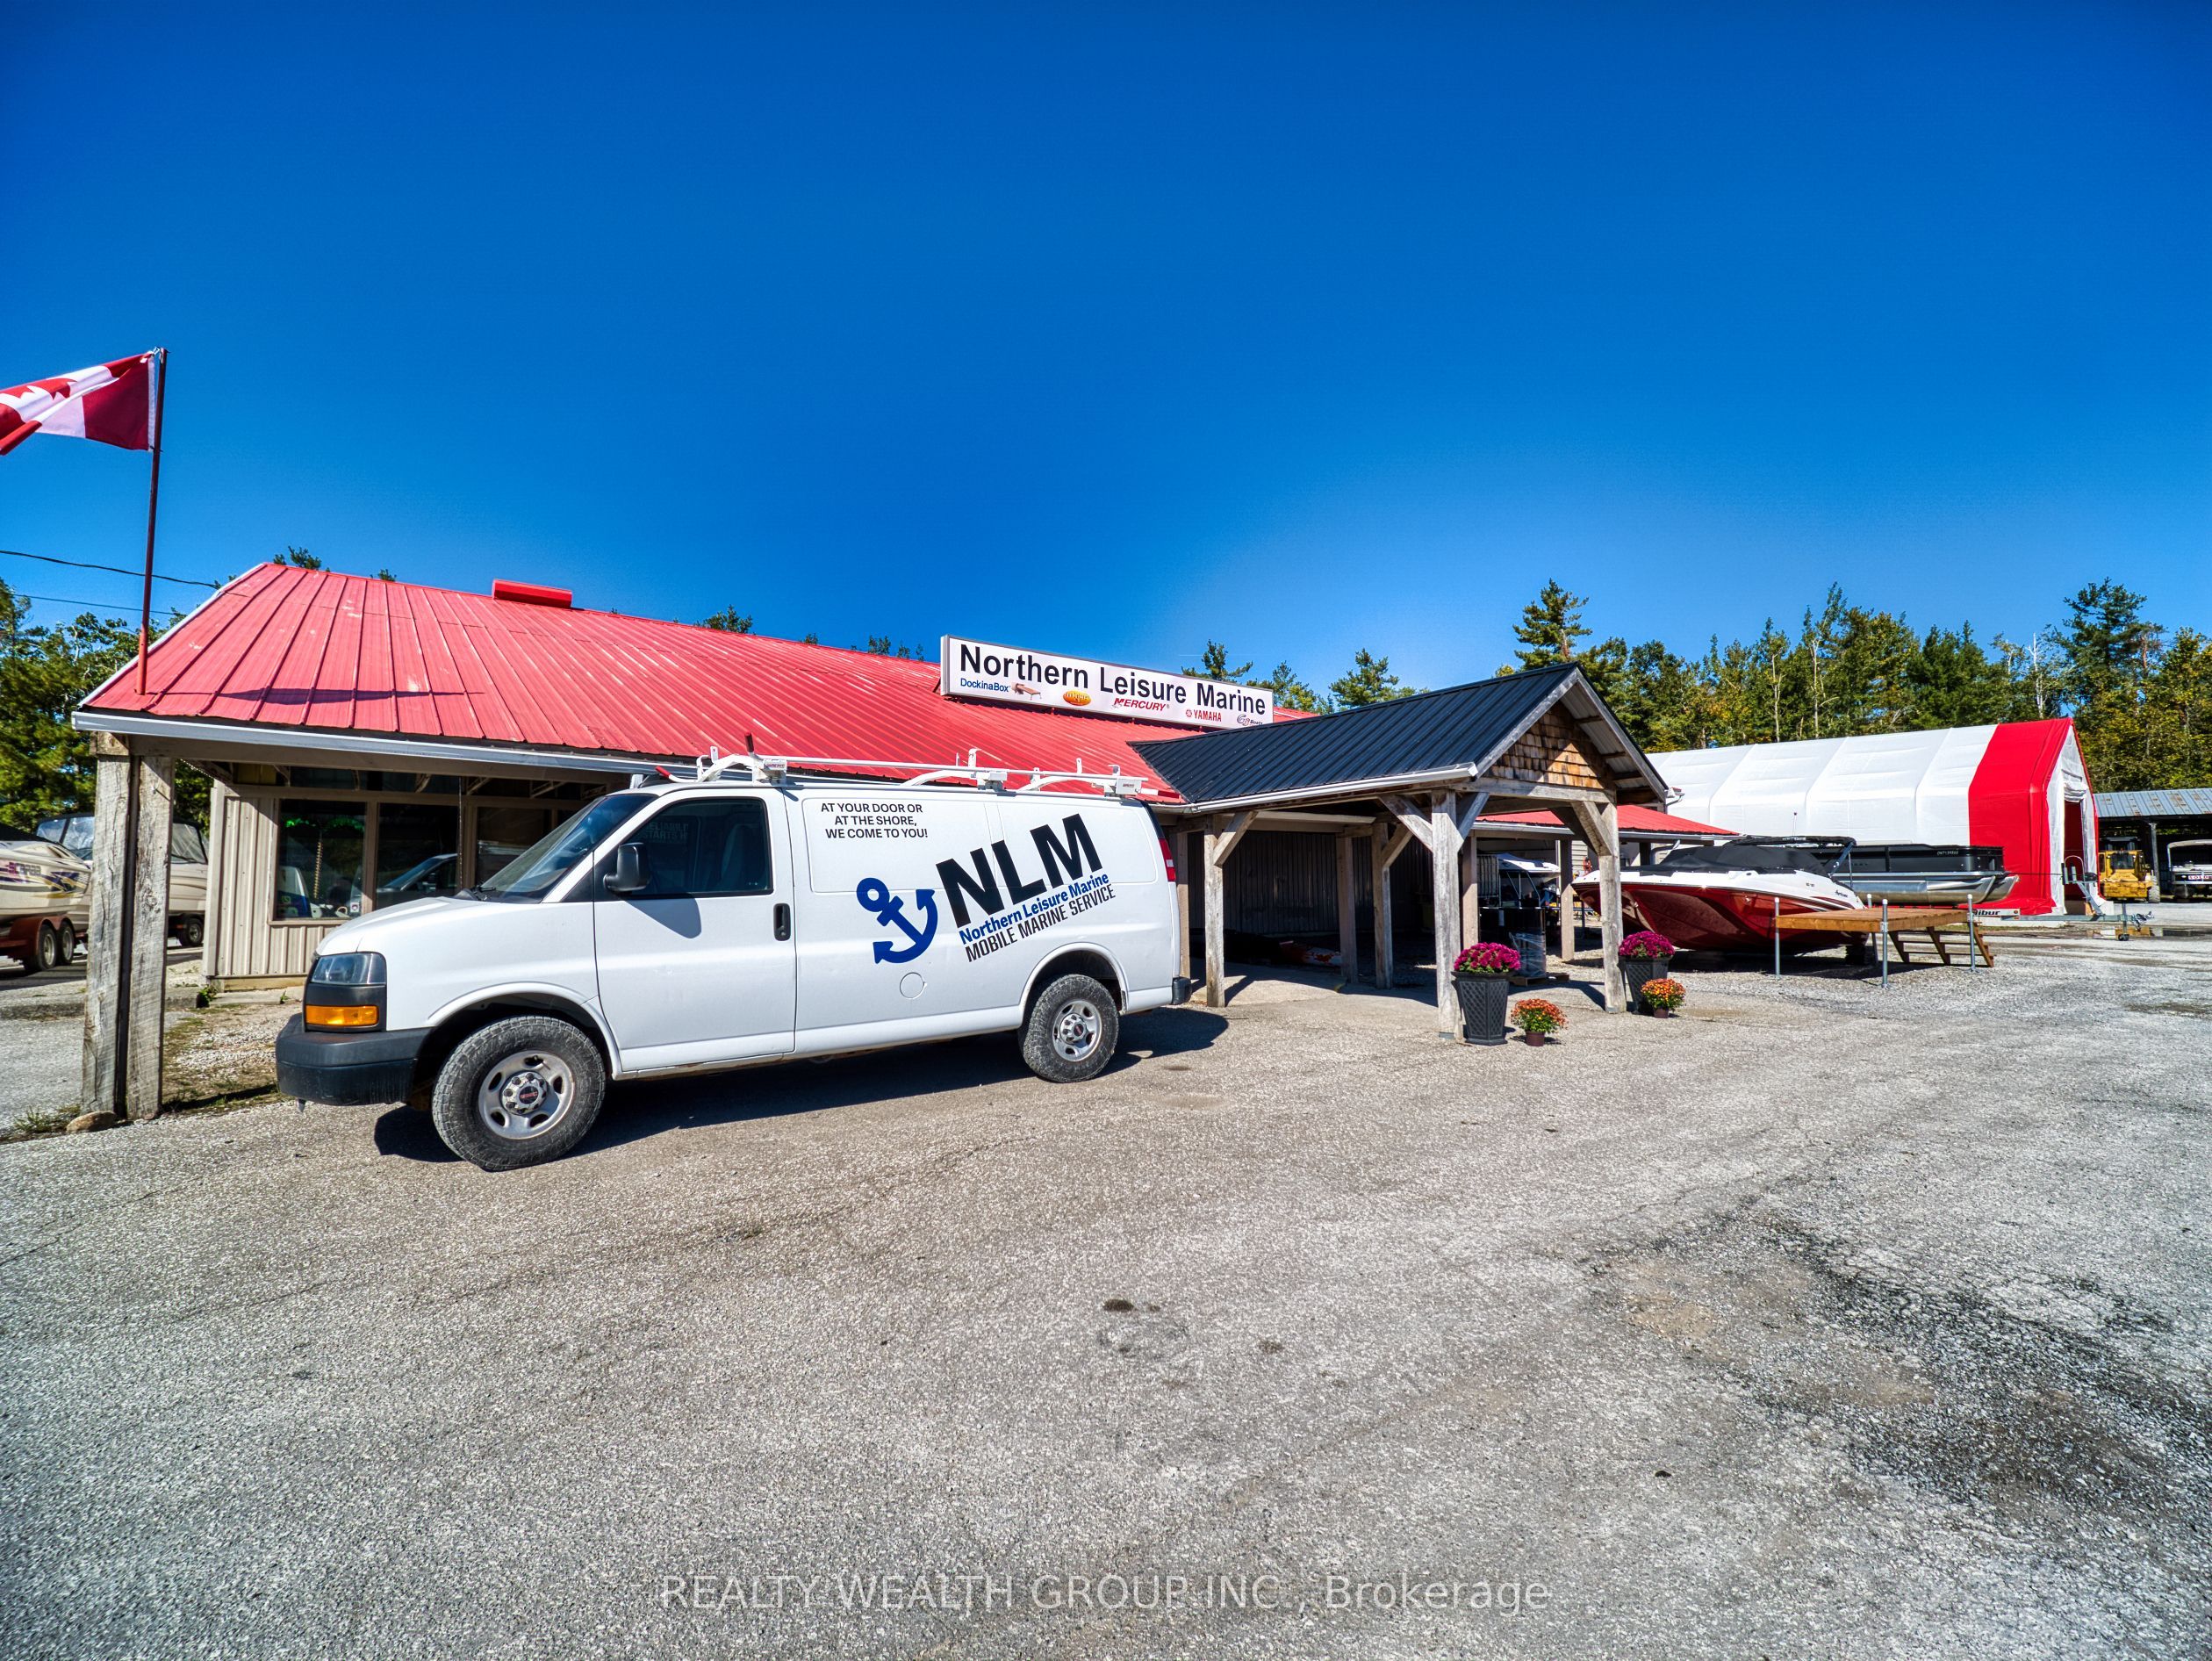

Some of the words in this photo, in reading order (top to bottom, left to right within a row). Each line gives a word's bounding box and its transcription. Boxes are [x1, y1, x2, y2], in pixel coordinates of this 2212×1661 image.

[960, 644, 1088, 689] Northern
[1100, 666, 1187, 704] Leisure
[1196, 682, 1266, 715] Marine
[960, 678, 1009, 693] DockinaBox
[1114, 697, 1167, 711] MERCURY
[1193, 708, 1222, 723] YAMAHA
[821, 802, 836, 813] AT
[837, 802, 871, 813] YOUR
[872, 803, 906, 813] DOOR
[907, 803, 923, 813] OR
[834, 816, 849, 825] AT
[850, 816, 875, 825] THE
[876, 816, 917, 827] SHORE,
[825, 828, 845, 838] WE
[847, 828, 883, 838] COME
[883, 828, 900, 838] TO
[901, 828, 929, 838] YOU!
[936, 813, 1103, 929] NLM
[959, 910, 1023, 945] Northern
[1022, 890, 1069, 918] Leisure
[1067, 874, 1110, 899] Marine
[965, 926, 1018, 963] MOBILE
[1017, 904, 1068, 939] MARINE
[1068, 883, 1117, 917] SERVICE
